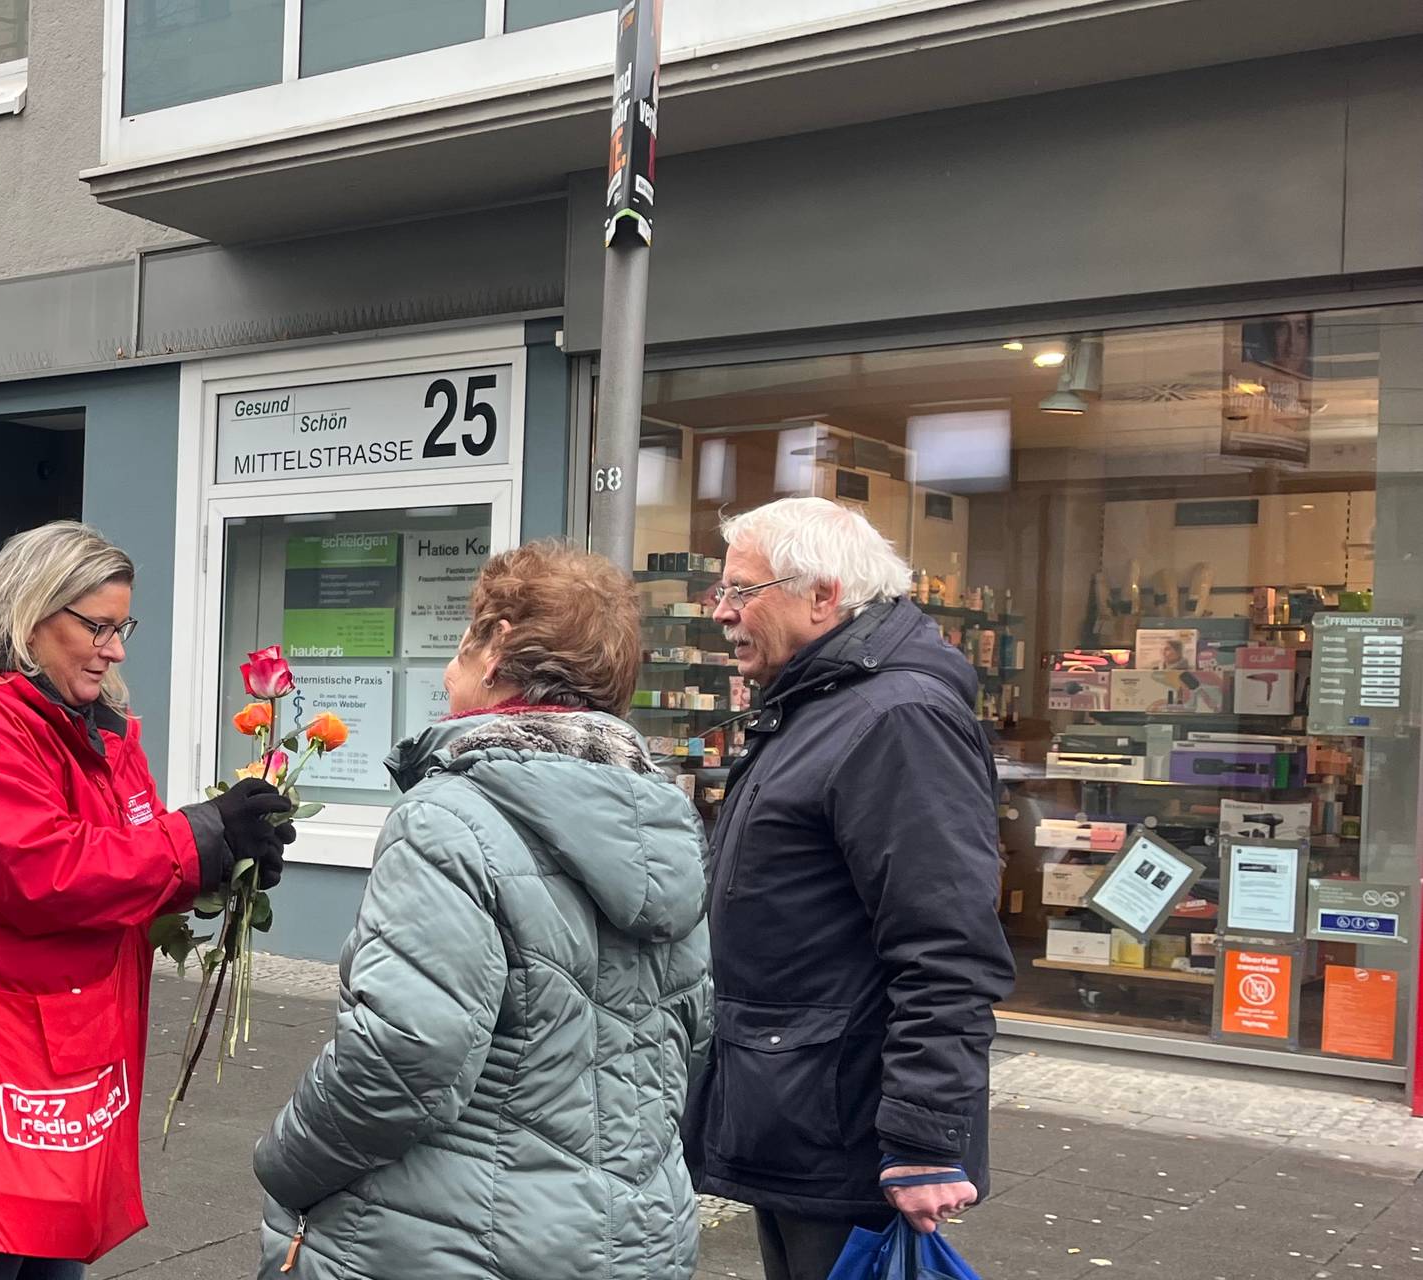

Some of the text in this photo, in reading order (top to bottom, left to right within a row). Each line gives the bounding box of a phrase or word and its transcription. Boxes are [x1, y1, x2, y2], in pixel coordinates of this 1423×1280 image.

[234, 395, 290, 418] Gesund
[299, 412, 348, 433] Schön
[422, 374, 497, 459] 25
[234, 440, 414, 475] MITTELSTRASSE
[595, 466, 622, 492] 68
[418, 539, 460, 557] Hatice
[1324, 615, 1404, 627] ÖFFNUNGSZEITEN
[289, 644, 344, 657] hautarzt
[293, 675, 383, 685] Internistische Praxis
[312, 700, 367, 709] Crispin Webber
[9, 1093, 66, 1117] 107.7
[21, 1118, 82, 1135] radio
